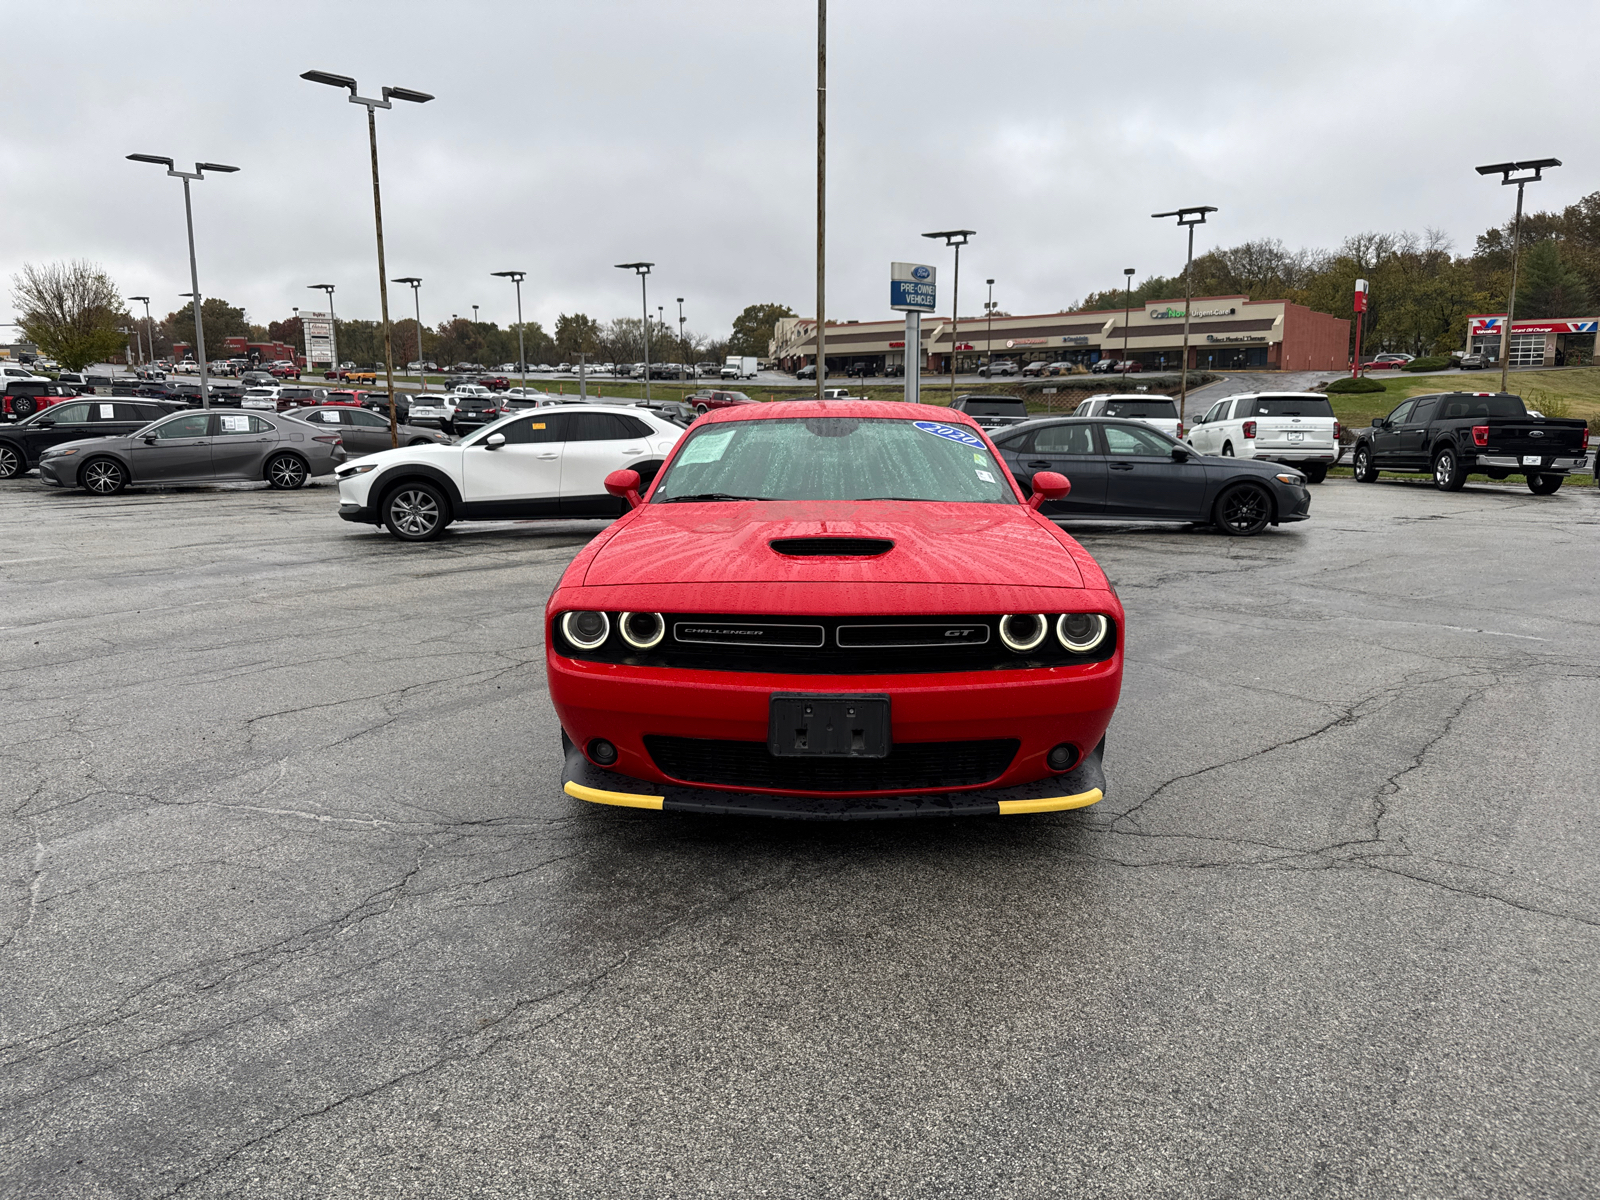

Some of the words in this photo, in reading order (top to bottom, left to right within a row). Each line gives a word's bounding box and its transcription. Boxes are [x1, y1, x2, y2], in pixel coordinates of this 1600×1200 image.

[906, 294, 934, 305] VEHICLES
[1192, 309, 1212, 318] Urgent
[924, 424, 978, 444] 2020
